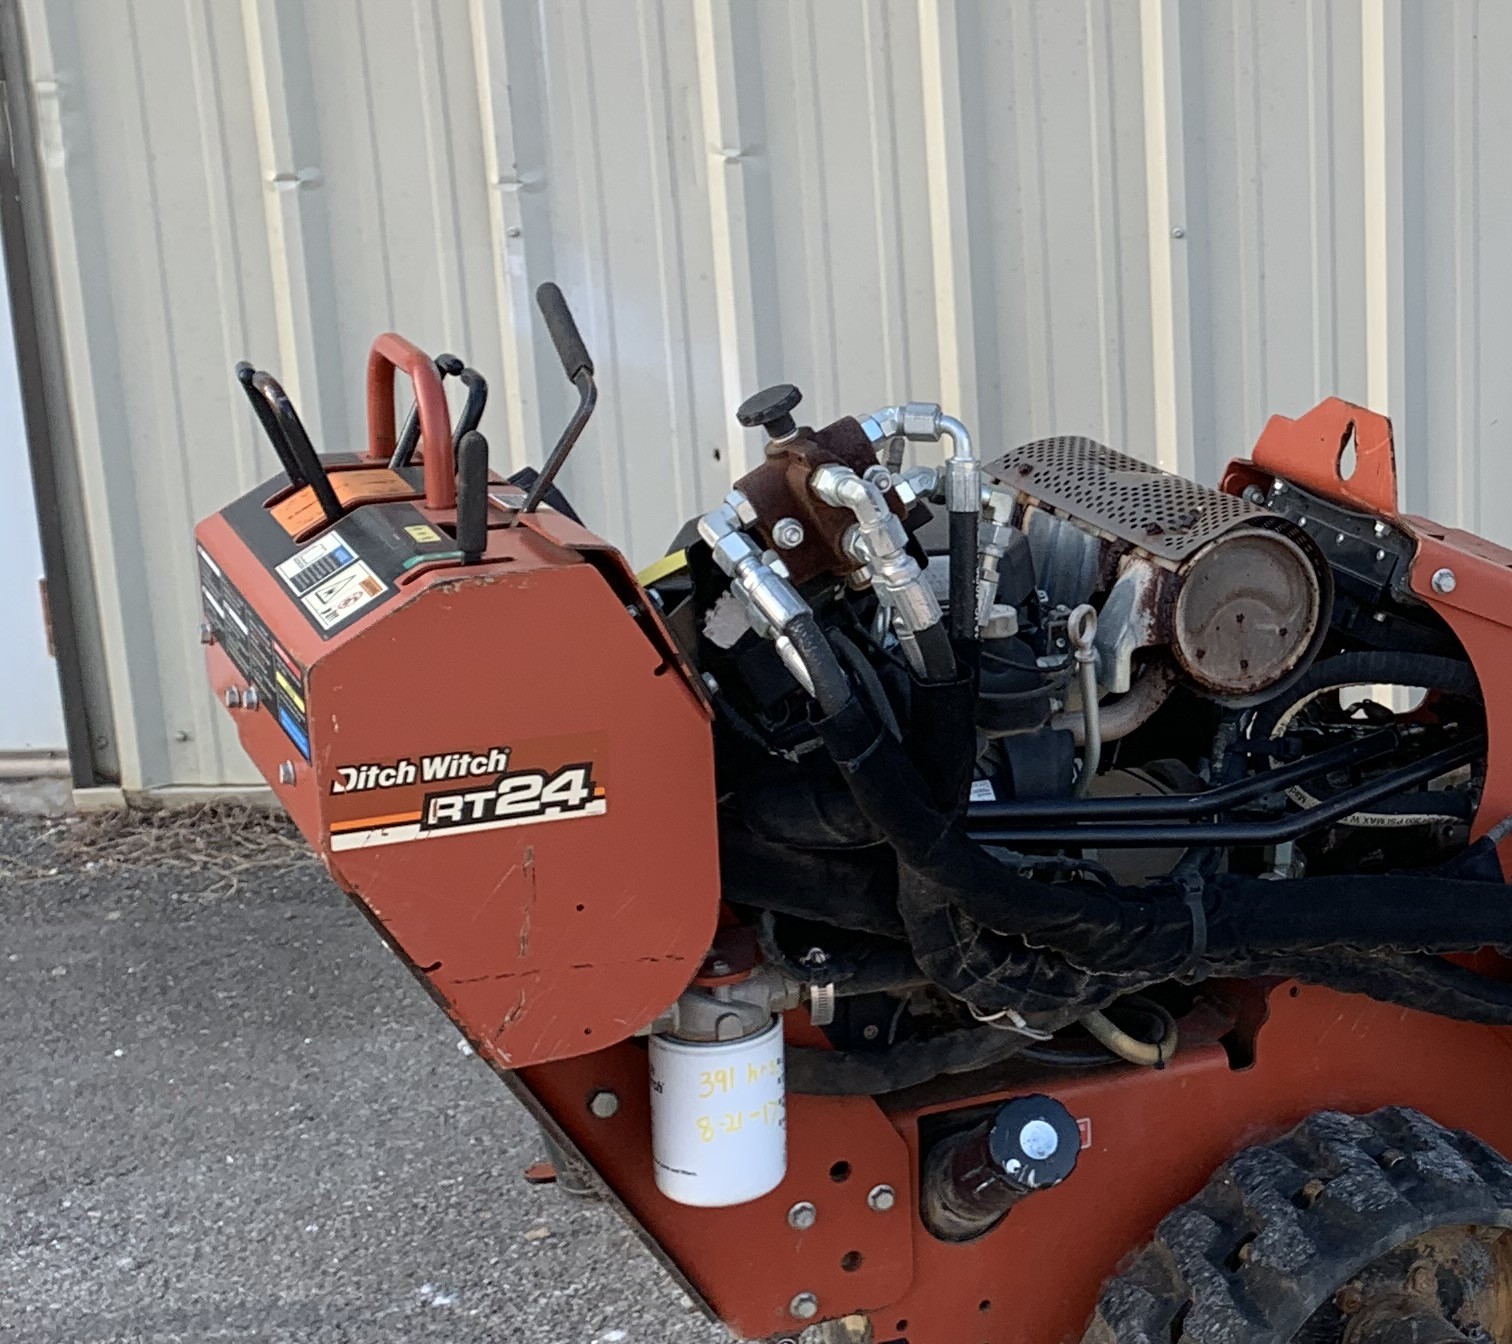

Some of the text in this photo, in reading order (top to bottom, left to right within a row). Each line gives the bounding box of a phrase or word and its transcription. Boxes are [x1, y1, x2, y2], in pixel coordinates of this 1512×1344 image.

[332, 748, 508, 794] Ditch Witch
[427, 768, 589, 825] RT24
[699, 1066, 735, 1098] 391
